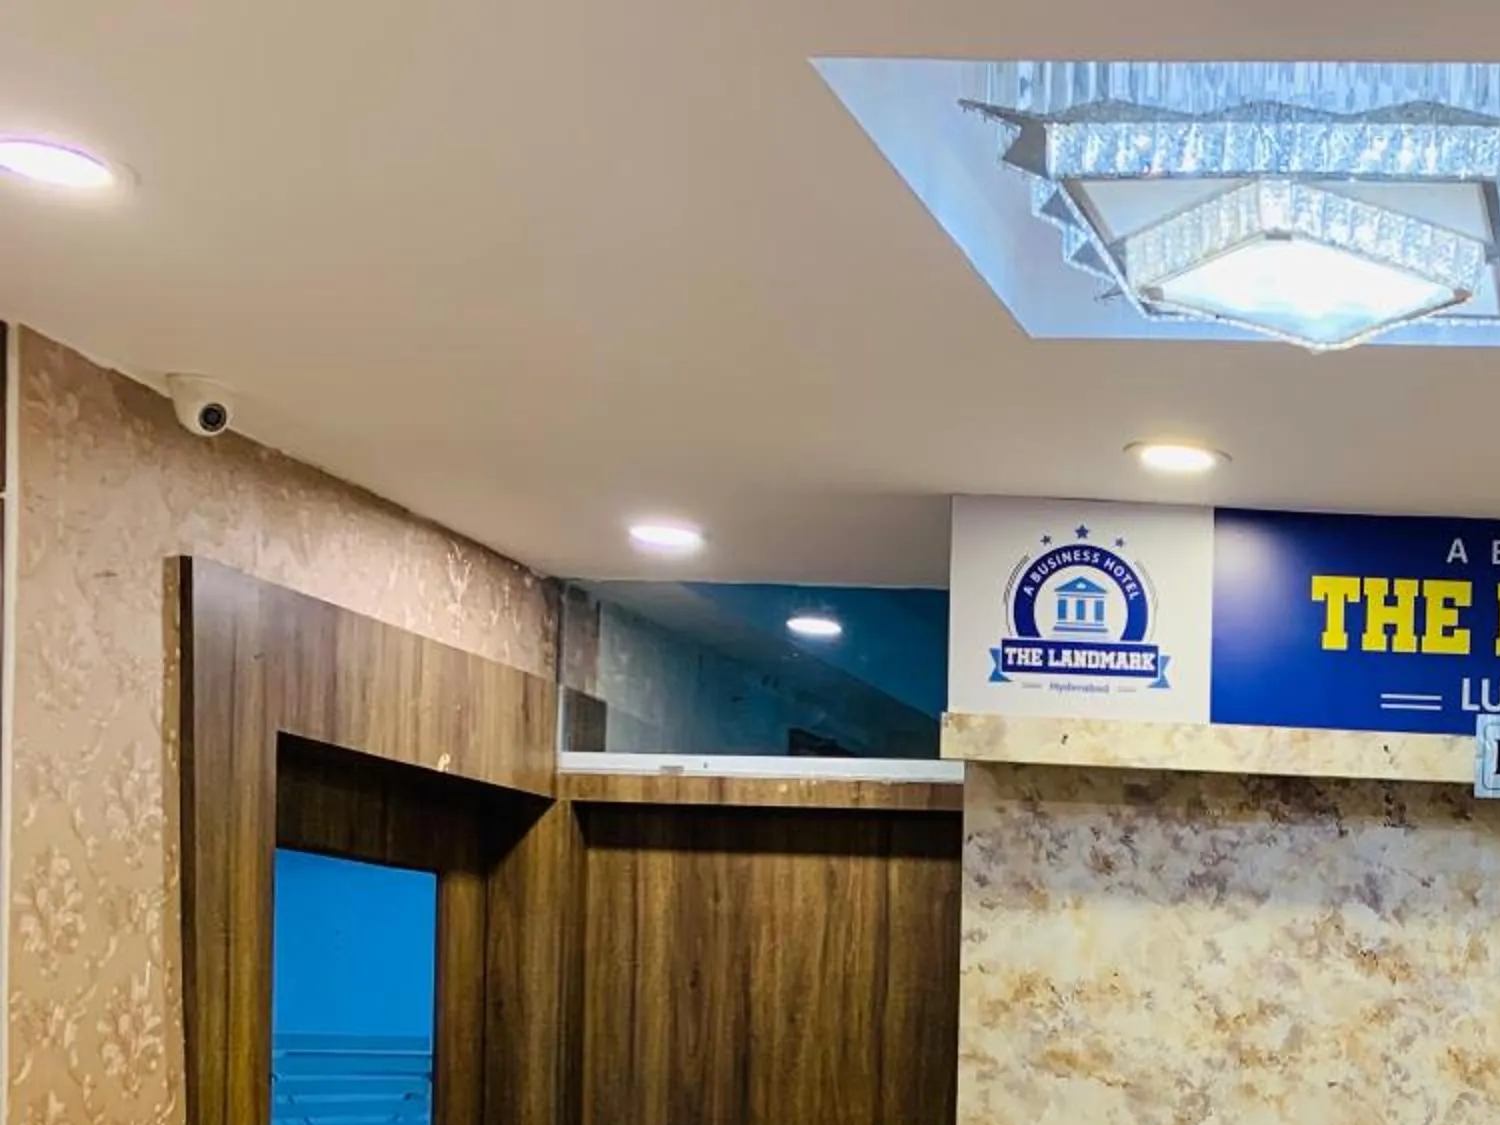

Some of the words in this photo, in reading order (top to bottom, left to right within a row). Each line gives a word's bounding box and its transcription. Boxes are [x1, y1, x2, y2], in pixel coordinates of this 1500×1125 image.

[1447, 538, 1468, 563] A
[1023, 587, 1036, 601] A
[1031, 550, 1101, 583] BUSINESS
[1103, 557, 1142, 600] HOTEL
[1311, 575, 1472, 655] THE
[1004, 647, 1043, 667] THE
[1047, 648, 1157, 671] LANDMARK
